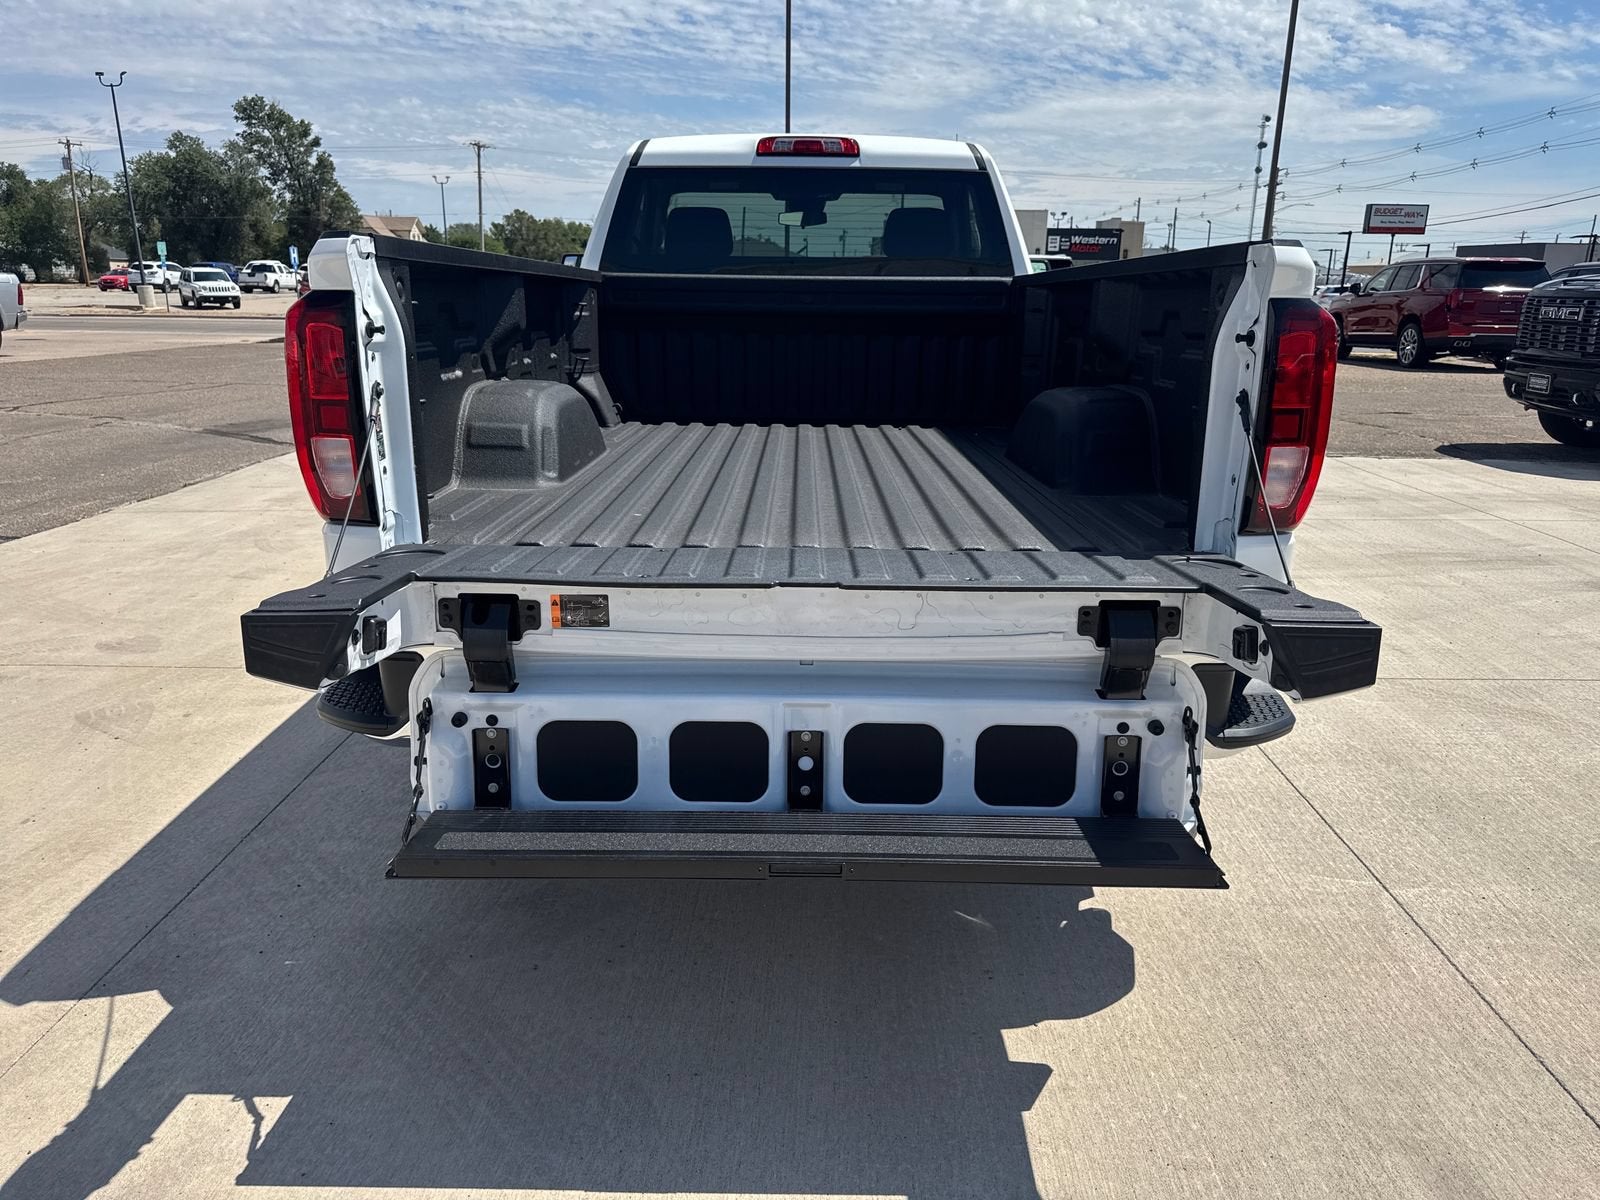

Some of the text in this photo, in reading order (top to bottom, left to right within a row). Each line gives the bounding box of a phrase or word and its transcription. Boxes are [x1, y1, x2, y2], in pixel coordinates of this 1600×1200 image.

[1071, 235, 1118, 245] Western
[1071, 244, 1102, 253] Motor
[1539, 306, 1580, 320] GMC
